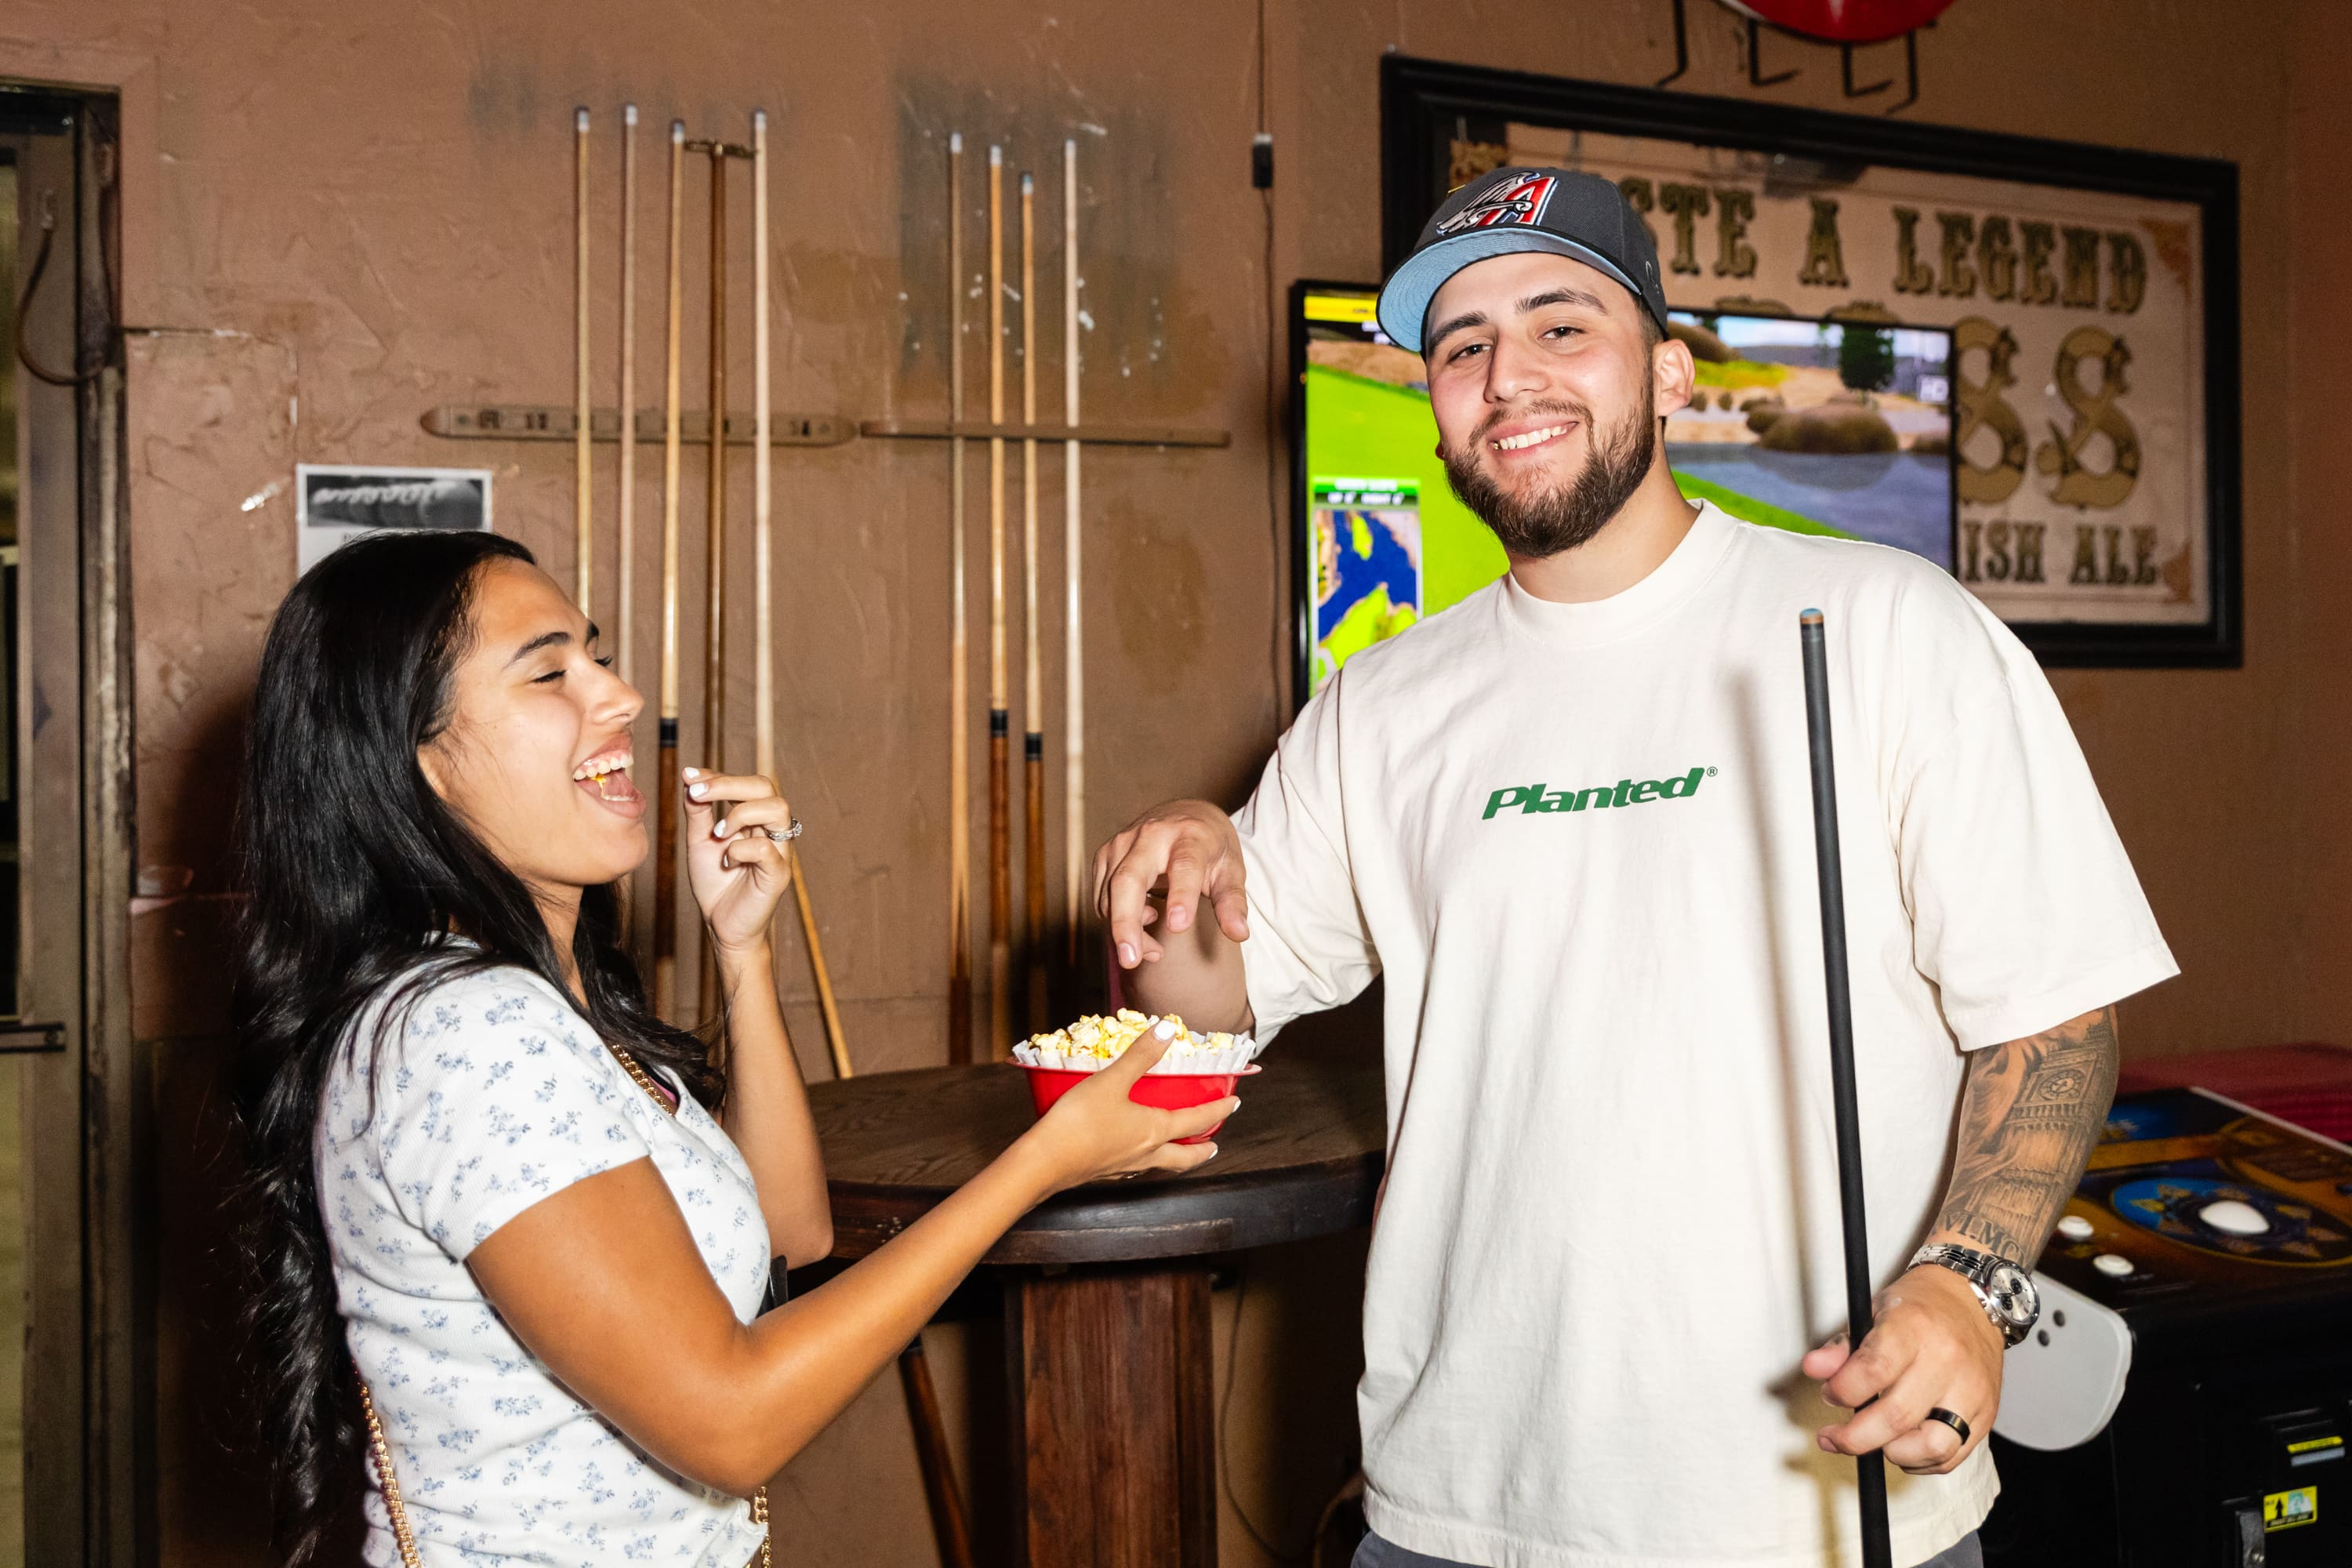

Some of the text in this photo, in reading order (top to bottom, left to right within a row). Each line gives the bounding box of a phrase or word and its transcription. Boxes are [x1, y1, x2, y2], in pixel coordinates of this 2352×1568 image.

[1798, 198, 1849, 288] A
[1892, 205, 2147, 315] LEGEND
[2070, 525, 2157, 586] ALE
